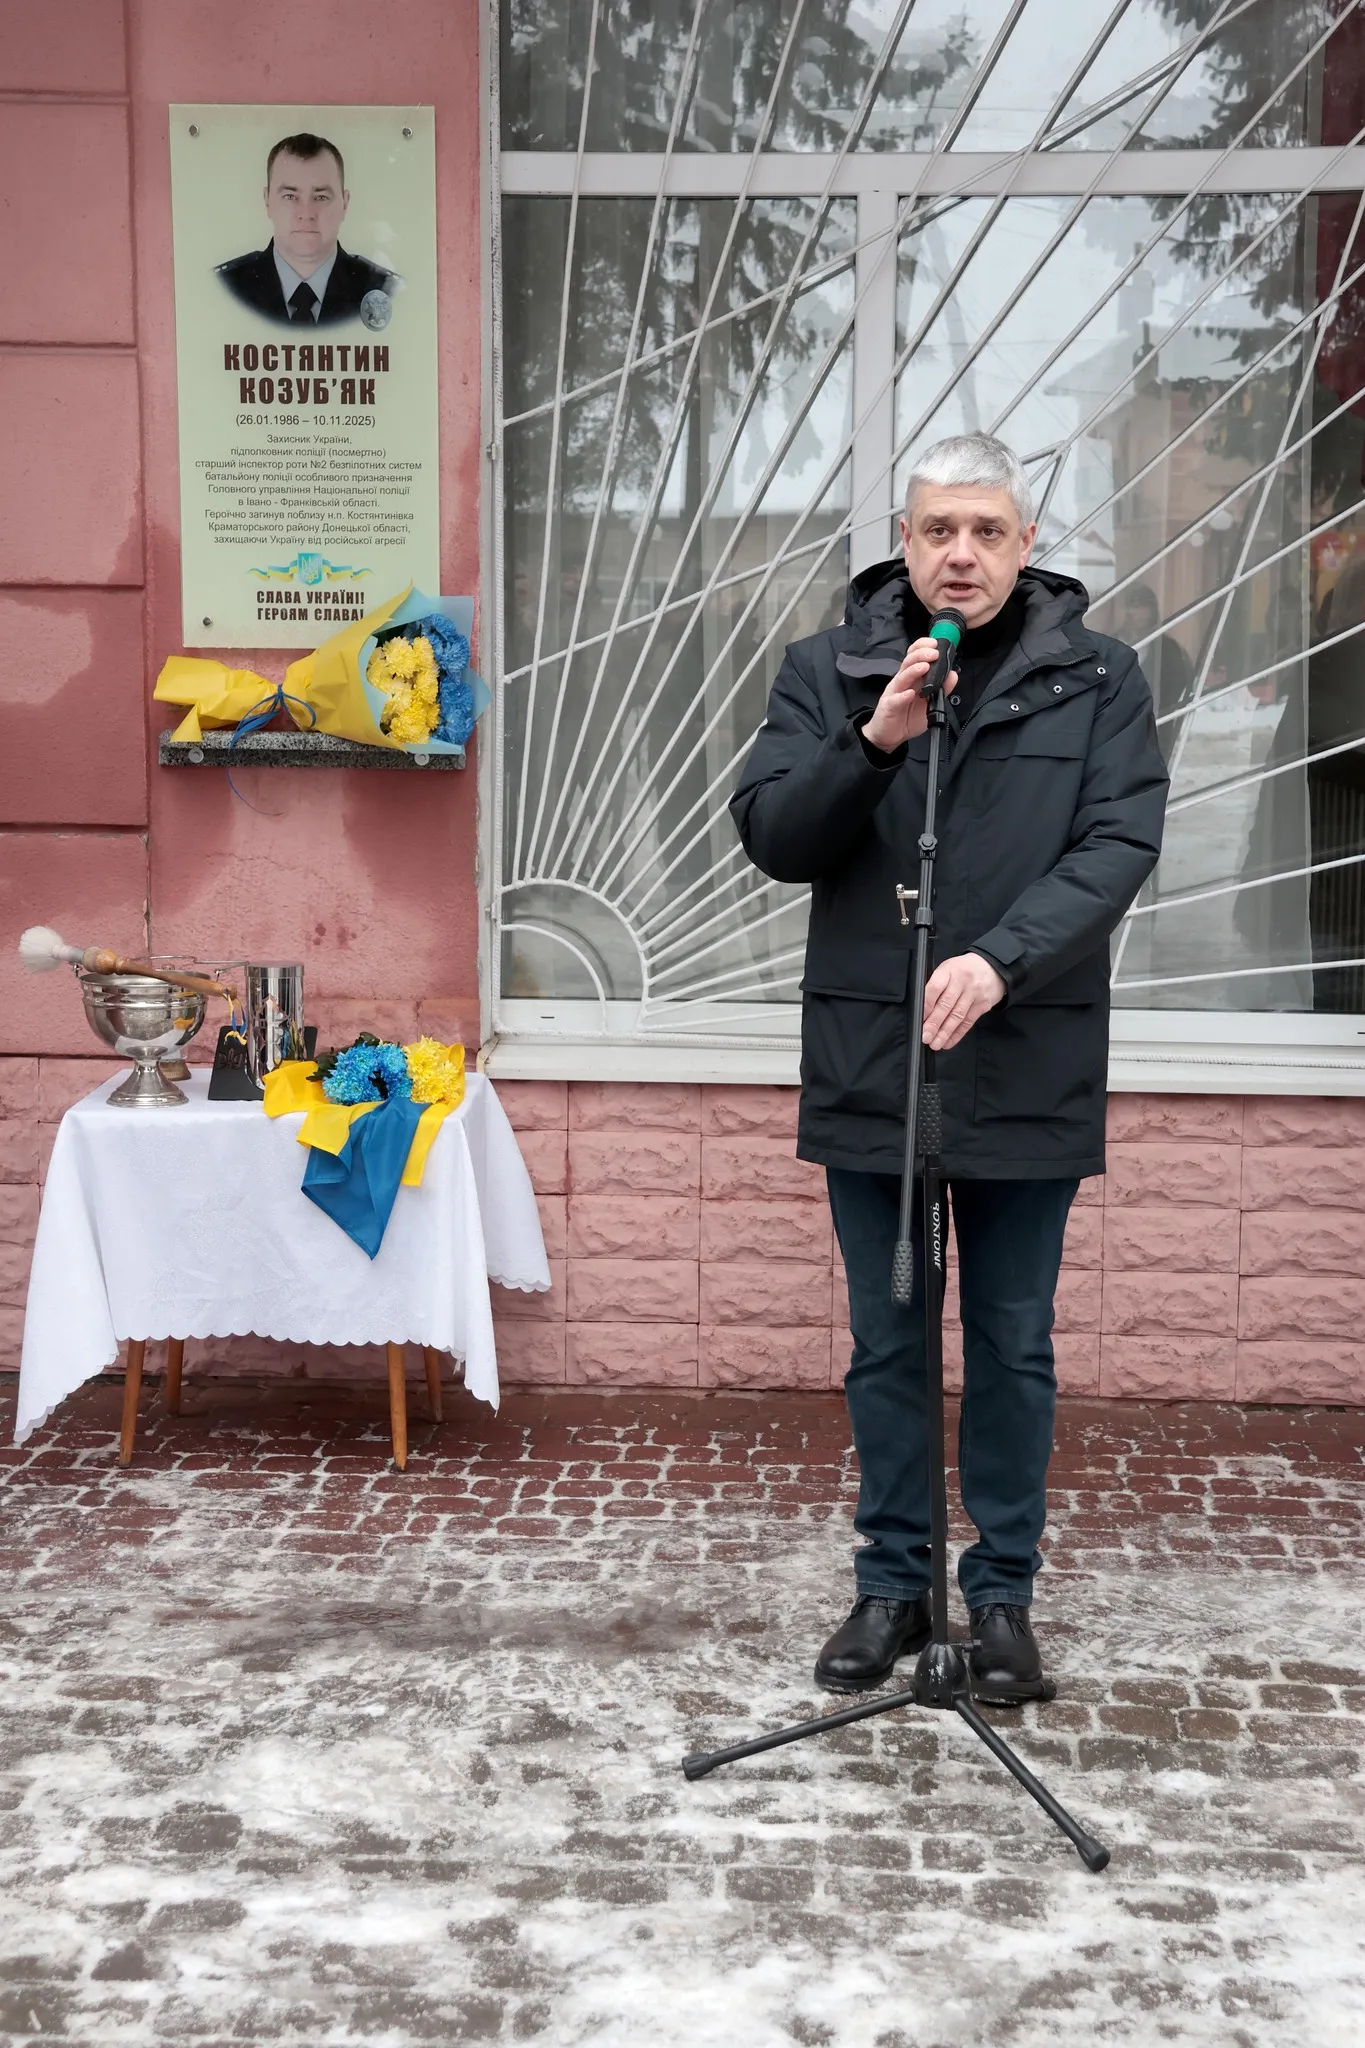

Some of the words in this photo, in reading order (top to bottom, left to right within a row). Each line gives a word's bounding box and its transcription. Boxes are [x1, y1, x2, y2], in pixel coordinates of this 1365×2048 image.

[224, 344, 389, 372] КОСТЯНТИН
[236, 414, 300, 426] (26.01.1986
[313, 414, 376, 428] 10.11.2025)
[267, 435, 311, 444] Захисник
[313, 434, 352, 445] України,
[231, 447, 293, 458] підполковник
[295, 447, 326, 458] поліції
[329, 448, 387, 459] (посмертно)
[195, 460, 236, 470] старший
[238, 460, 283, 471] інспектор
[286, 461, 308, 471] роти
[310, 460, 327, 470] №2
[330, 460, 386, 470] безпілотних
[389, 462, 422, 471] систем
[205, 472, 260, 483] батальйону
[263, 472, 293, 482] поліції
[295, 473, 349, 483] особливого
[352, 474, 413, 483] призначення
[208, 485, 256, 494] Головного
[259, 486, 311, 496] управління
[314, 485, 377, 495] Національної
[379, 486, 411, 496] поліції
[246, 498, 272, 507] Івано
[281, 497, 340, 507] Франківській
[343, 498, 380, 507] області.
[205, 510, 246, 519] Героїчно
[249, 511, 285, 520] загинув
[287, 510, 325, 521] поблизу
[327, 512, 345, 521] н.п.
[347, 511, 414, 520] Костянтинівка
[208, 522, 284, 533] Краматорського
[286, 523, 319, 534] району
[322, 523, 370, 534] Донецької
[373, 523, 411, 534] області,
[214, 535, 268, 546] захищаючи
[270, 535, 306, 546] Україну
[308, 535, 322, 546] від
[325, 536, 372, 546] російської
[374, 536, 406, 547] агресії
[257, 590, 301, 604] СЛАВА
[306, 589, 365, 605] УКРАЇНІ!
[257, 608, 308, 622] ГЕРОЯМ
